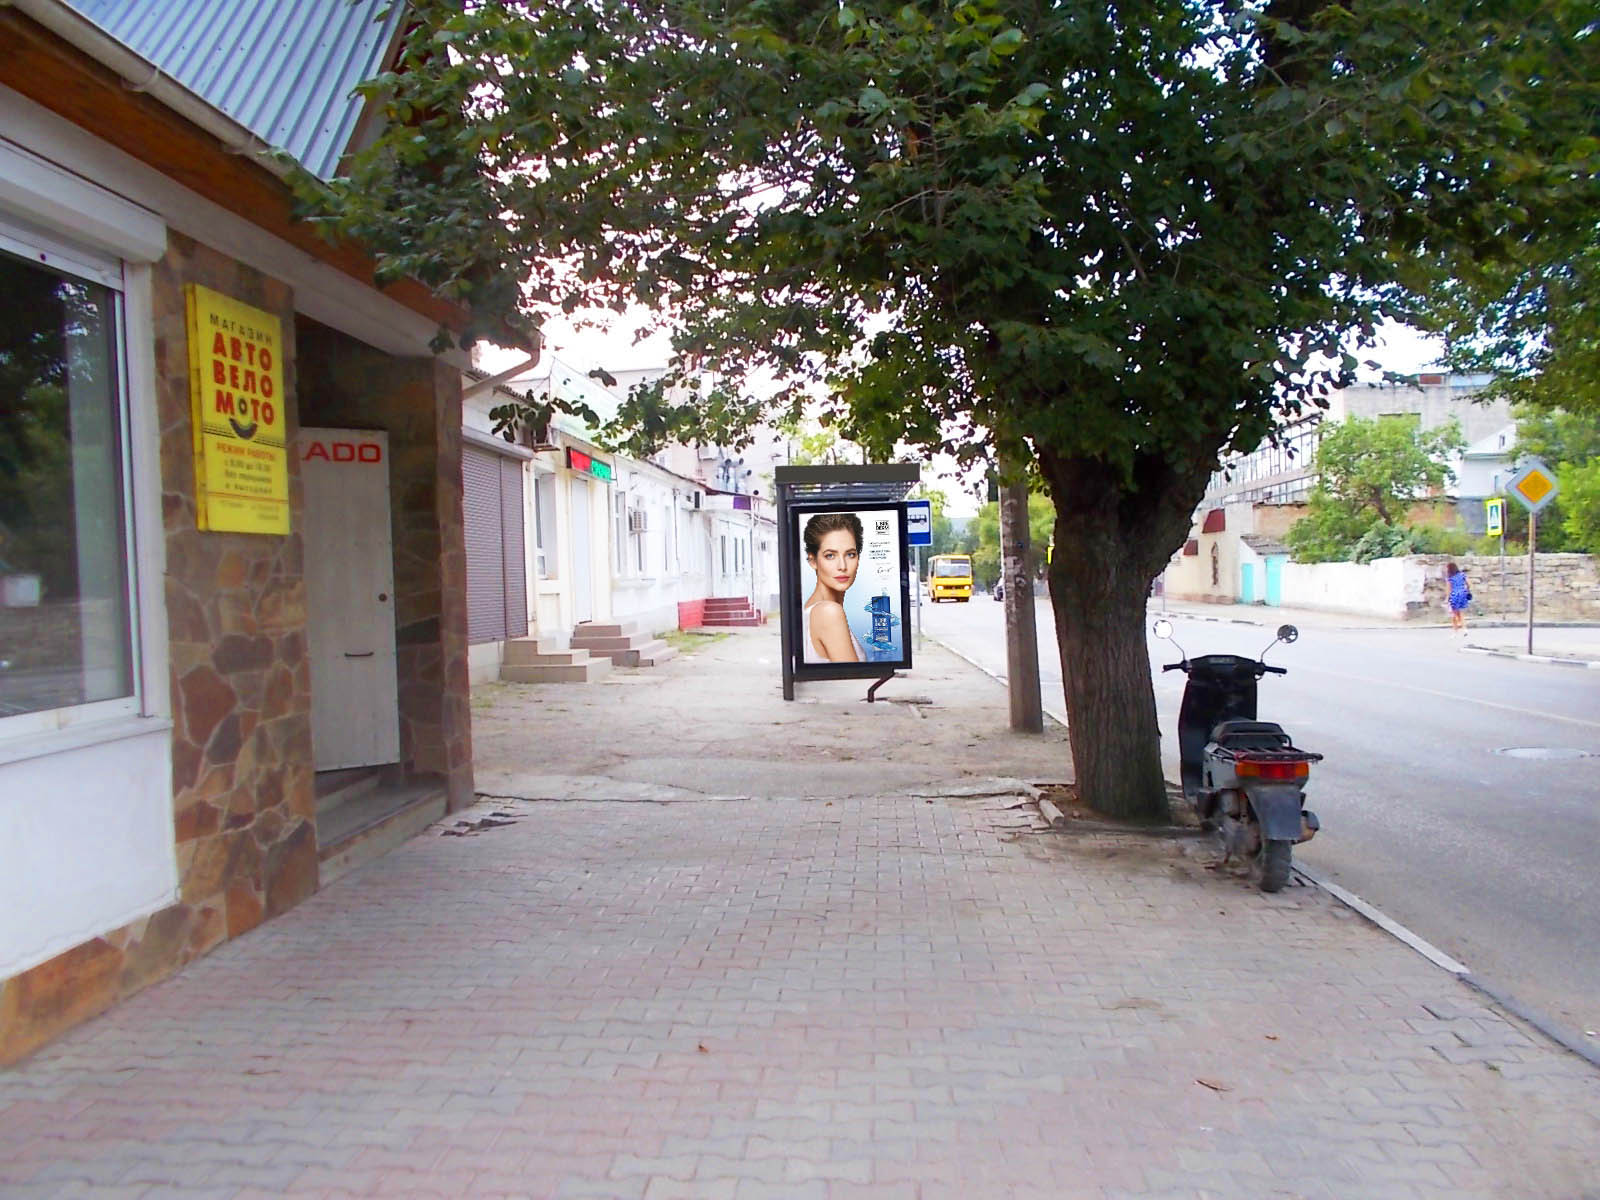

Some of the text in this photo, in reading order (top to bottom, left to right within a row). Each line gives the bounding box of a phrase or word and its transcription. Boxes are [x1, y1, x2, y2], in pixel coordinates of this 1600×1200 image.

[210, 313, 273, 346] МАГАЗИН
[213, 331, 273, 371] АВТО
[213, 359, 273, 399] ВЕЛО
[215, 389, 275, 426] МОТО
[301, 441, 383, 463] ADO
